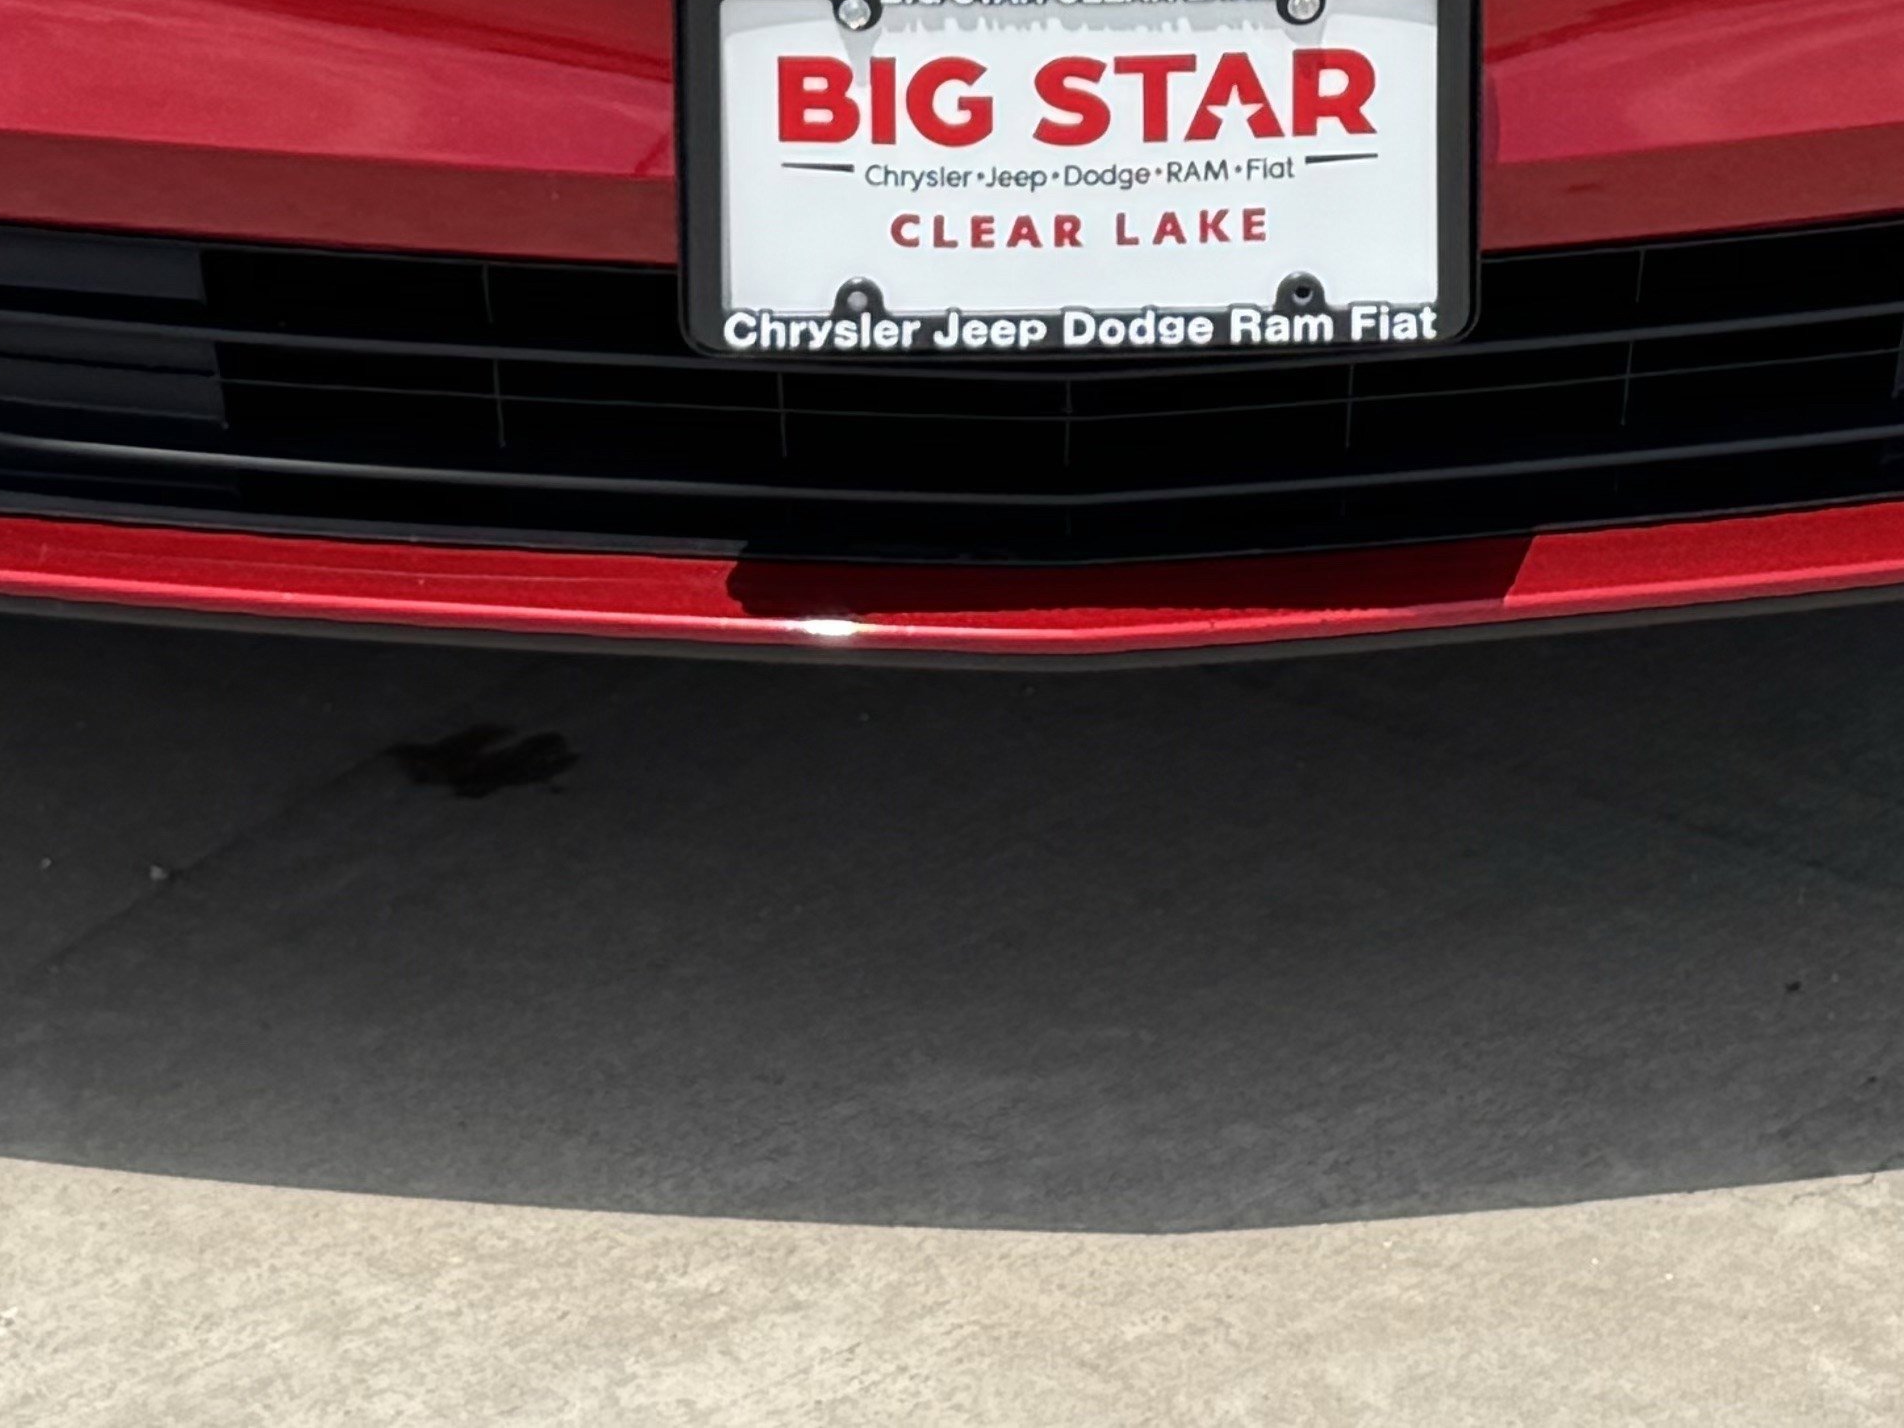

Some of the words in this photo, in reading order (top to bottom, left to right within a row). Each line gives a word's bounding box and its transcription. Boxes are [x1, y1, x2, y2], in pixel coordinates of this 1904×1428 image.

[778, 55, 994, 147] BIG
[1032, 48, 1378, 147] STAR
[864, 164, 973, 192] Chrysler
[985, 164, 1048, 193] Jeep
[1064, 162, 1150, 190] Dodge
[1166, 160, 1229, 183] RAM
[890, 214, 1083, 248] CLEAR
[1116, 207, 1267, 246] LAKE
[723, 311, 922, 350] Chrysler
[933, 310, 1047, 350] Jeep
[1062, 309, 1214, 347] Dodge
[1230, 308, 1334, 344] Ram
[1350, 305, 1438, 341] Fiat
